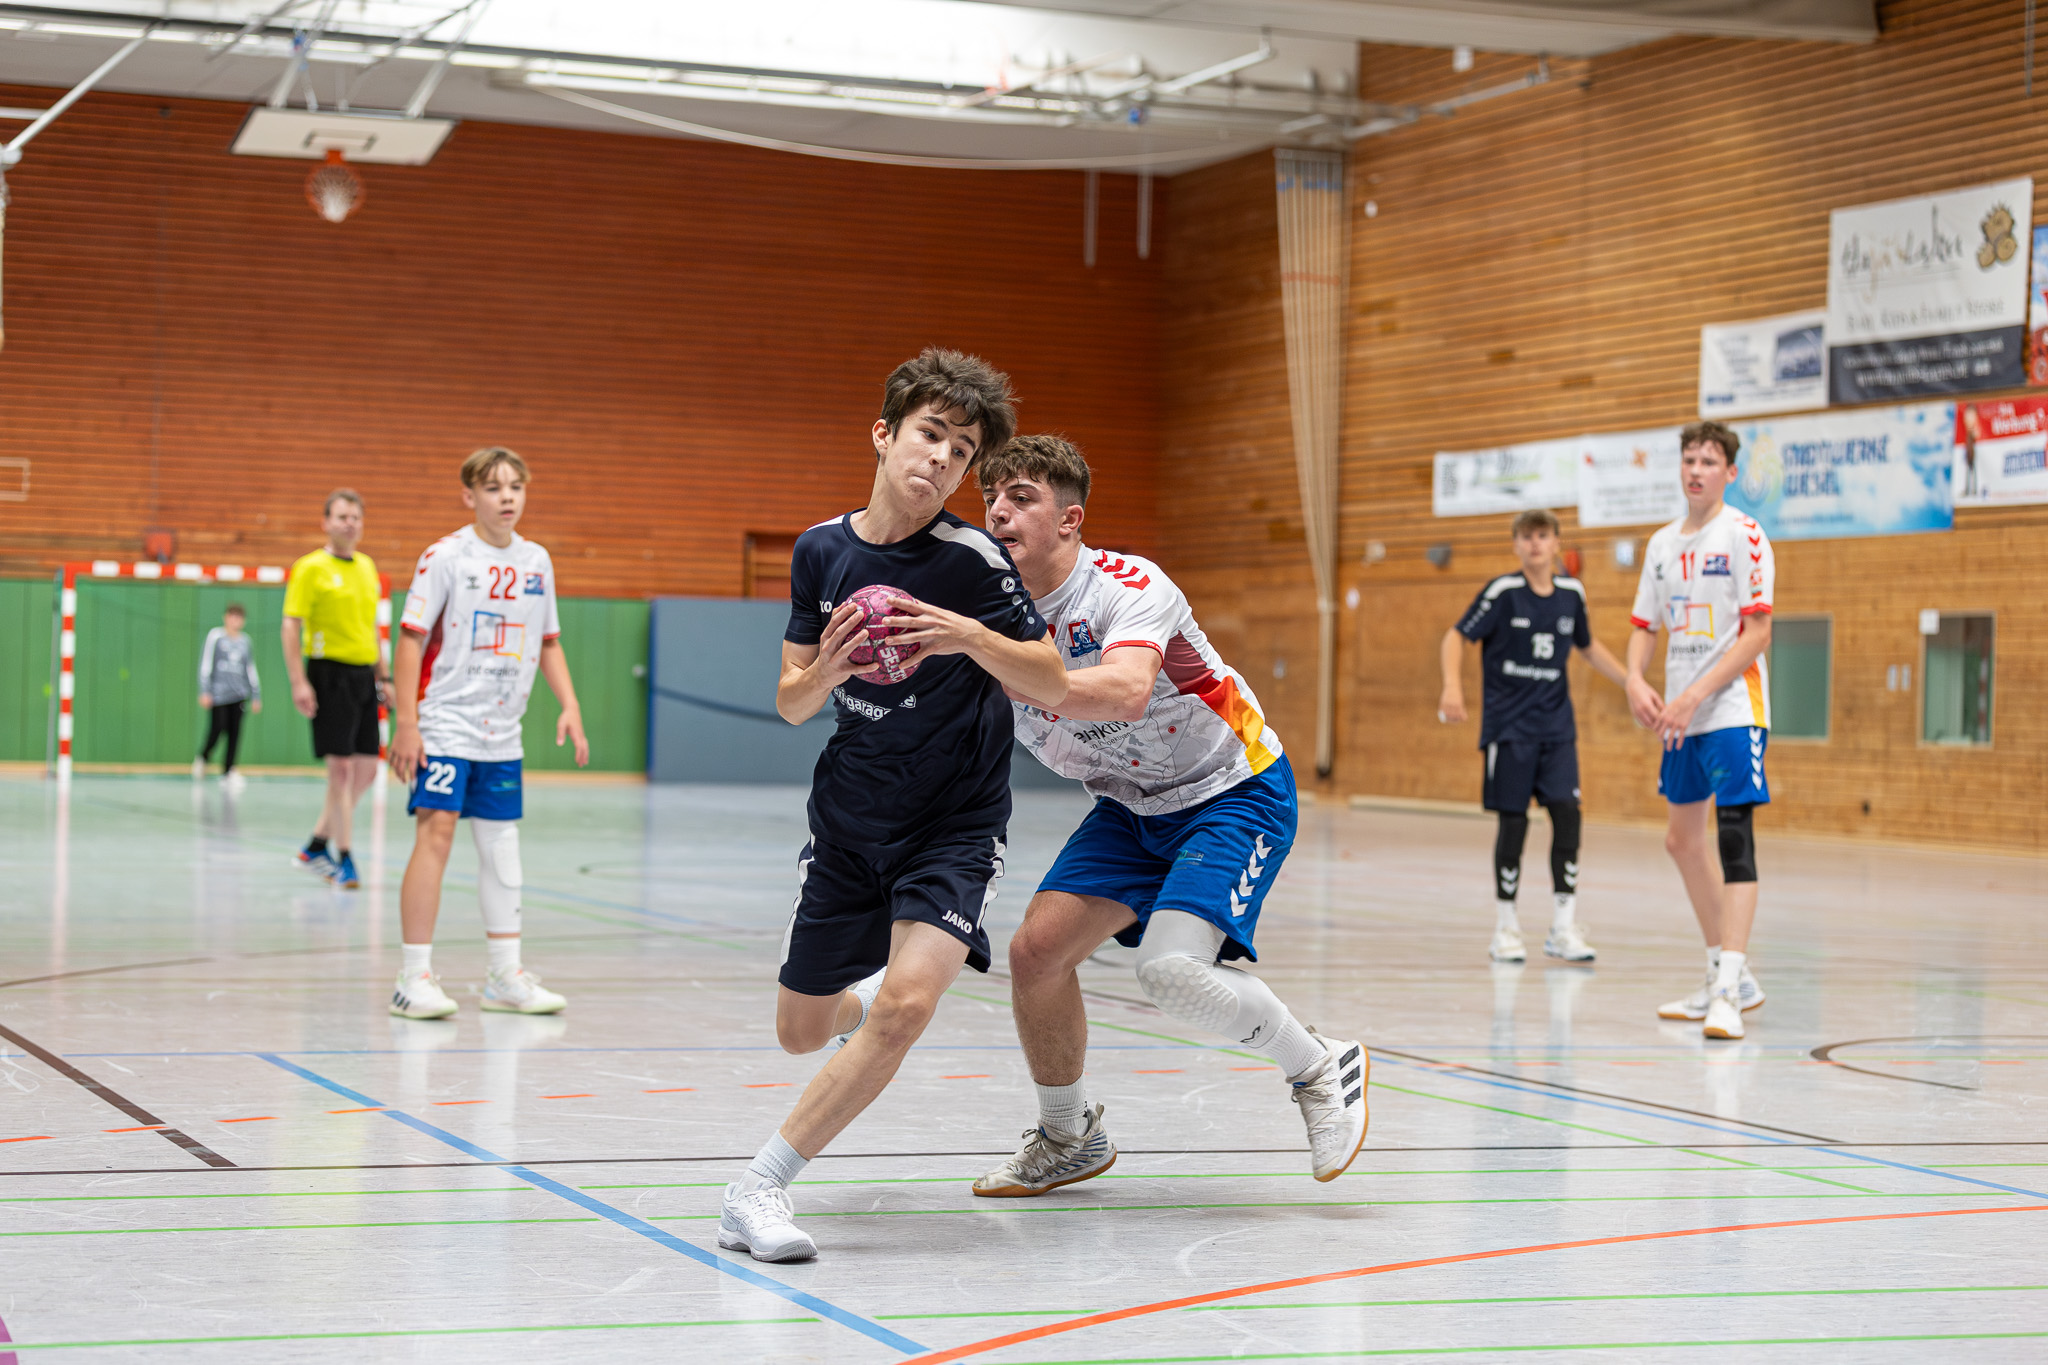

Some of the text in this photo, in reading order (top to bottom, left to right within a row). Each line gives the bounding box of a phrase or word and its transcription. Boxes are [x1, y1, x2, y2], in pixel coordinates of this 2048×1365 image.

[1680, 551, 1695, 581] 11
[489, 566, 516, 599] 22
[819, 601, 833, 613] KO
[1532, 632, 1555, 660] 15
[425, 761, 457, 795] 22
[941, 909, 973, 934] JAKO
